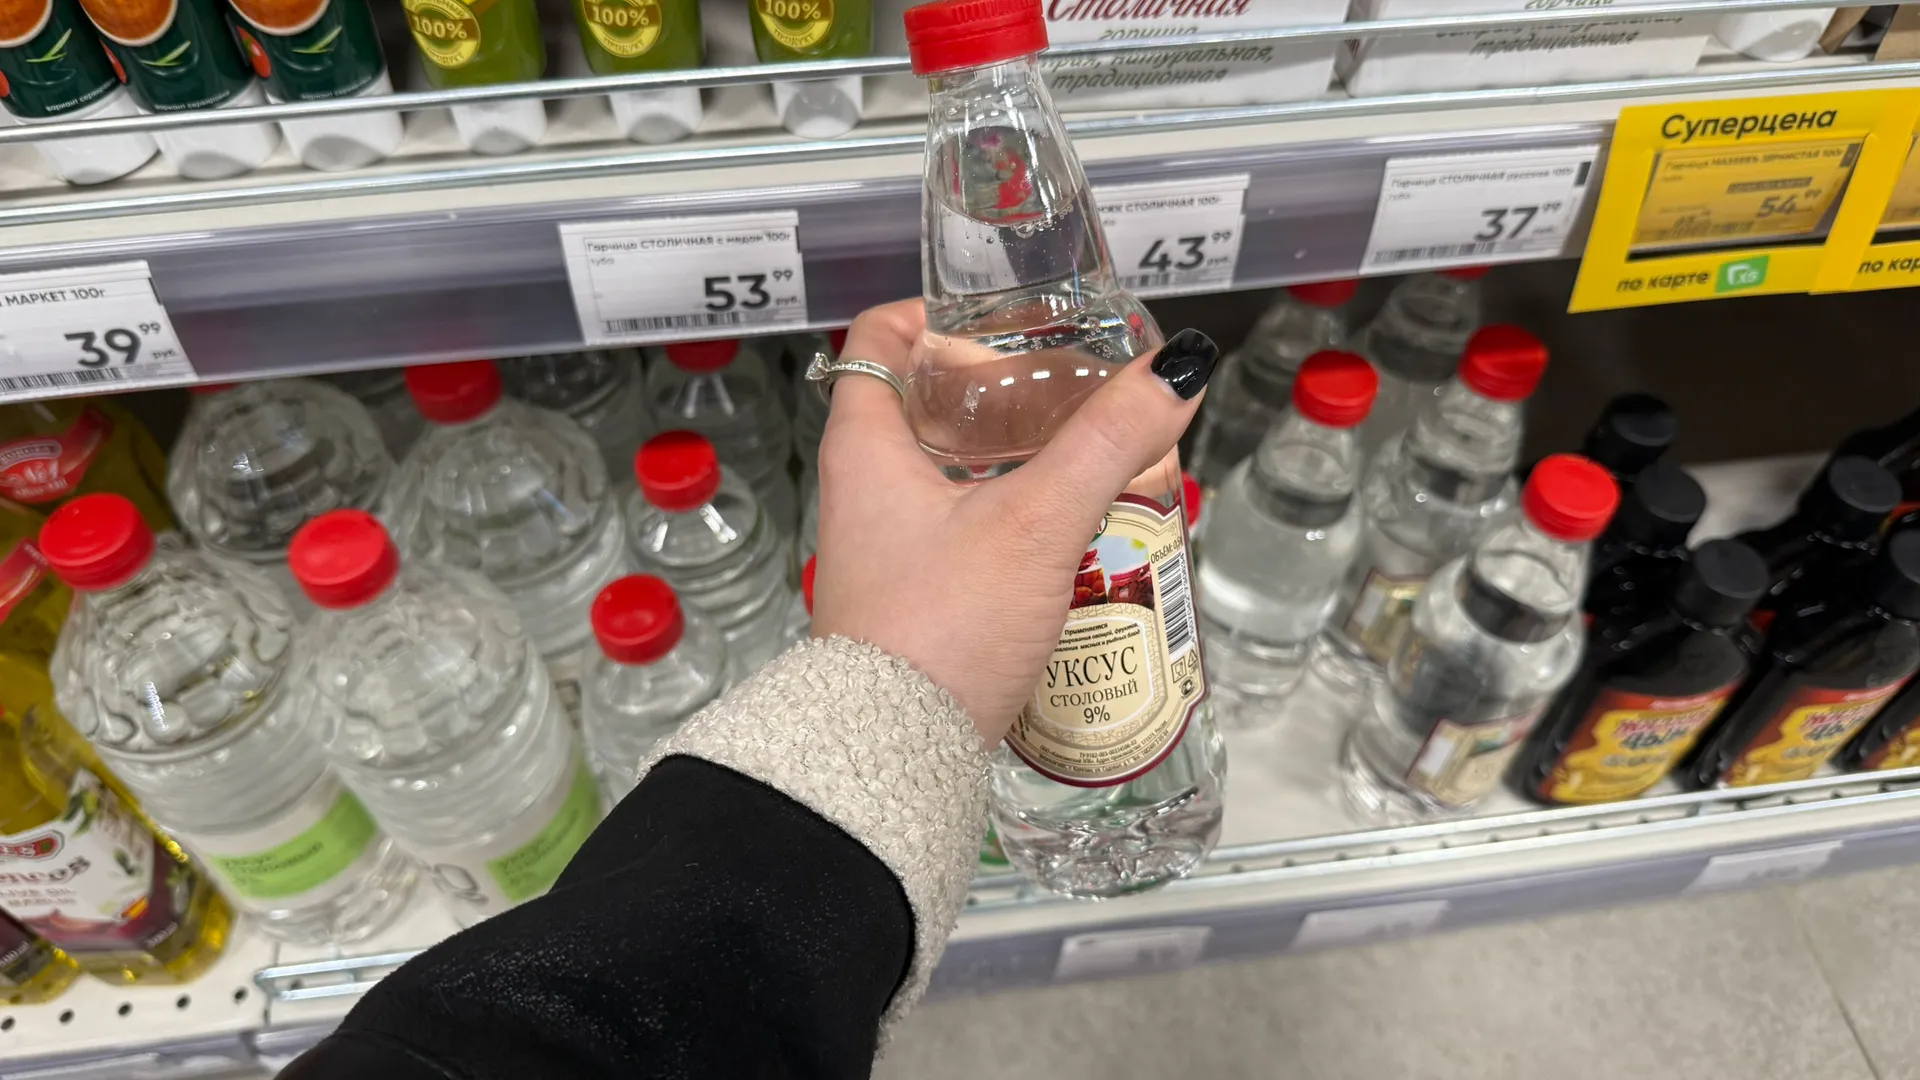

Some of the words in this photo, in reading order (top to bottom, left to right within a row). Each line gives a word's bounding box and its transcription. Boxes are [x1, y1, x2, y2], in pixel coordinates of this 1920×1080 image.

[411, 15, 468, 39] 100%
[592, 8, 650, 27] 100%
[1050, 67, 1229, 93] традиционная
[1661, 109, 1838, 143] Суперцена
[1474, 206, 1540, 241] 37
[587, 241, 638, 253] Горчица
[641, 236, 714, 249] СТОЛИЧНАЯ
[1138, 236, 1206, 272] 43
[1858, 260, 1884, 275] по
[704, 273, 771, 312] 53
[773, 269, 794, 283] 99
[1615, 277, 1644, 293] по
[1647, 270, 1711, 292] карте
[5, 290, 67, 307] МАРКЕТ
[71, 287, 106, 299] 100г
[64, 328, 142, 369] 39
[138, 321, 162, 336] 99
[1064, 622, 1108, 637] Применяется
[1046, 645, 1138, 688] УКСУС
[1050, 678, 1139, 707] СТОЛОВЫЙ
[1083, 704, 1111, 724] 9%
